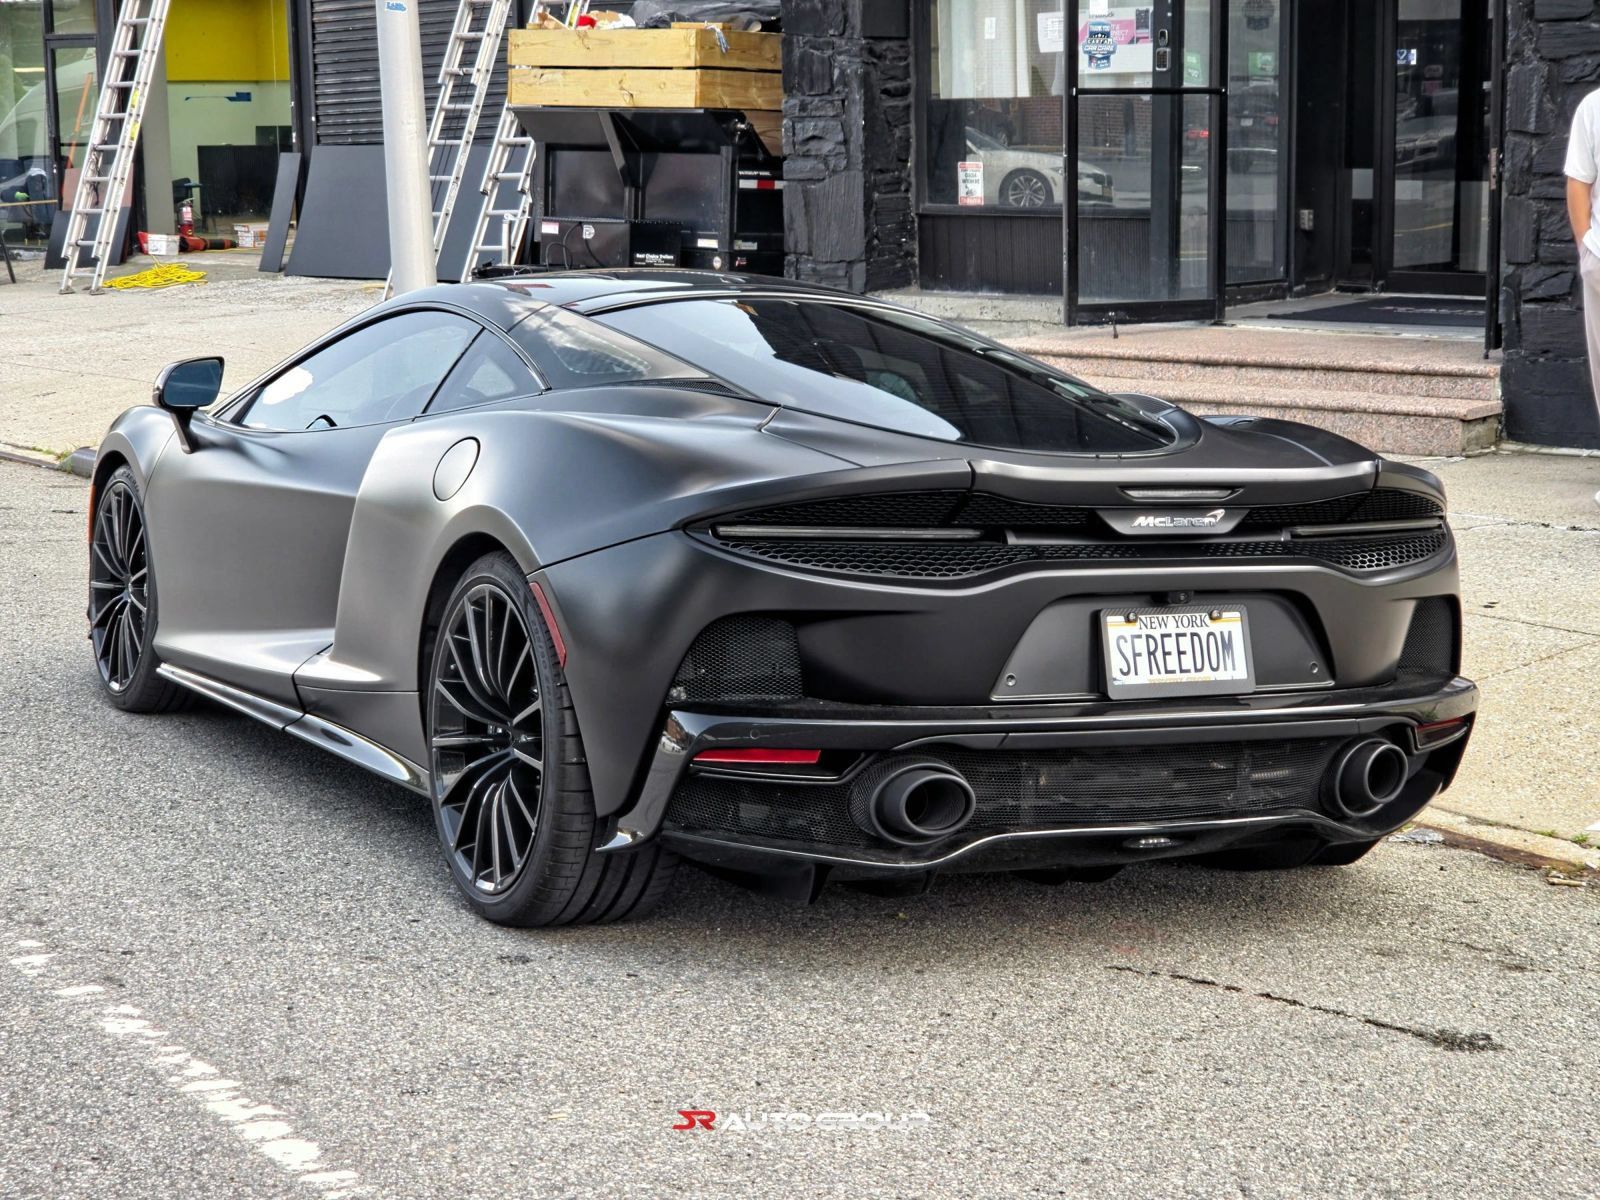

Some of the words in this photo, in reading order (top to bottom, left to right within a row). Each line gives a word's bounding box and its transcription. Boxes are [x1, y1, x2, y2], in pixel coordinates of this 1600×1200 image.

[1139, 615, 1170, 630] NEW
[1171, 613, 1210, 629] YORK
[1115, 630, 1237, 677] SFREEDOM
